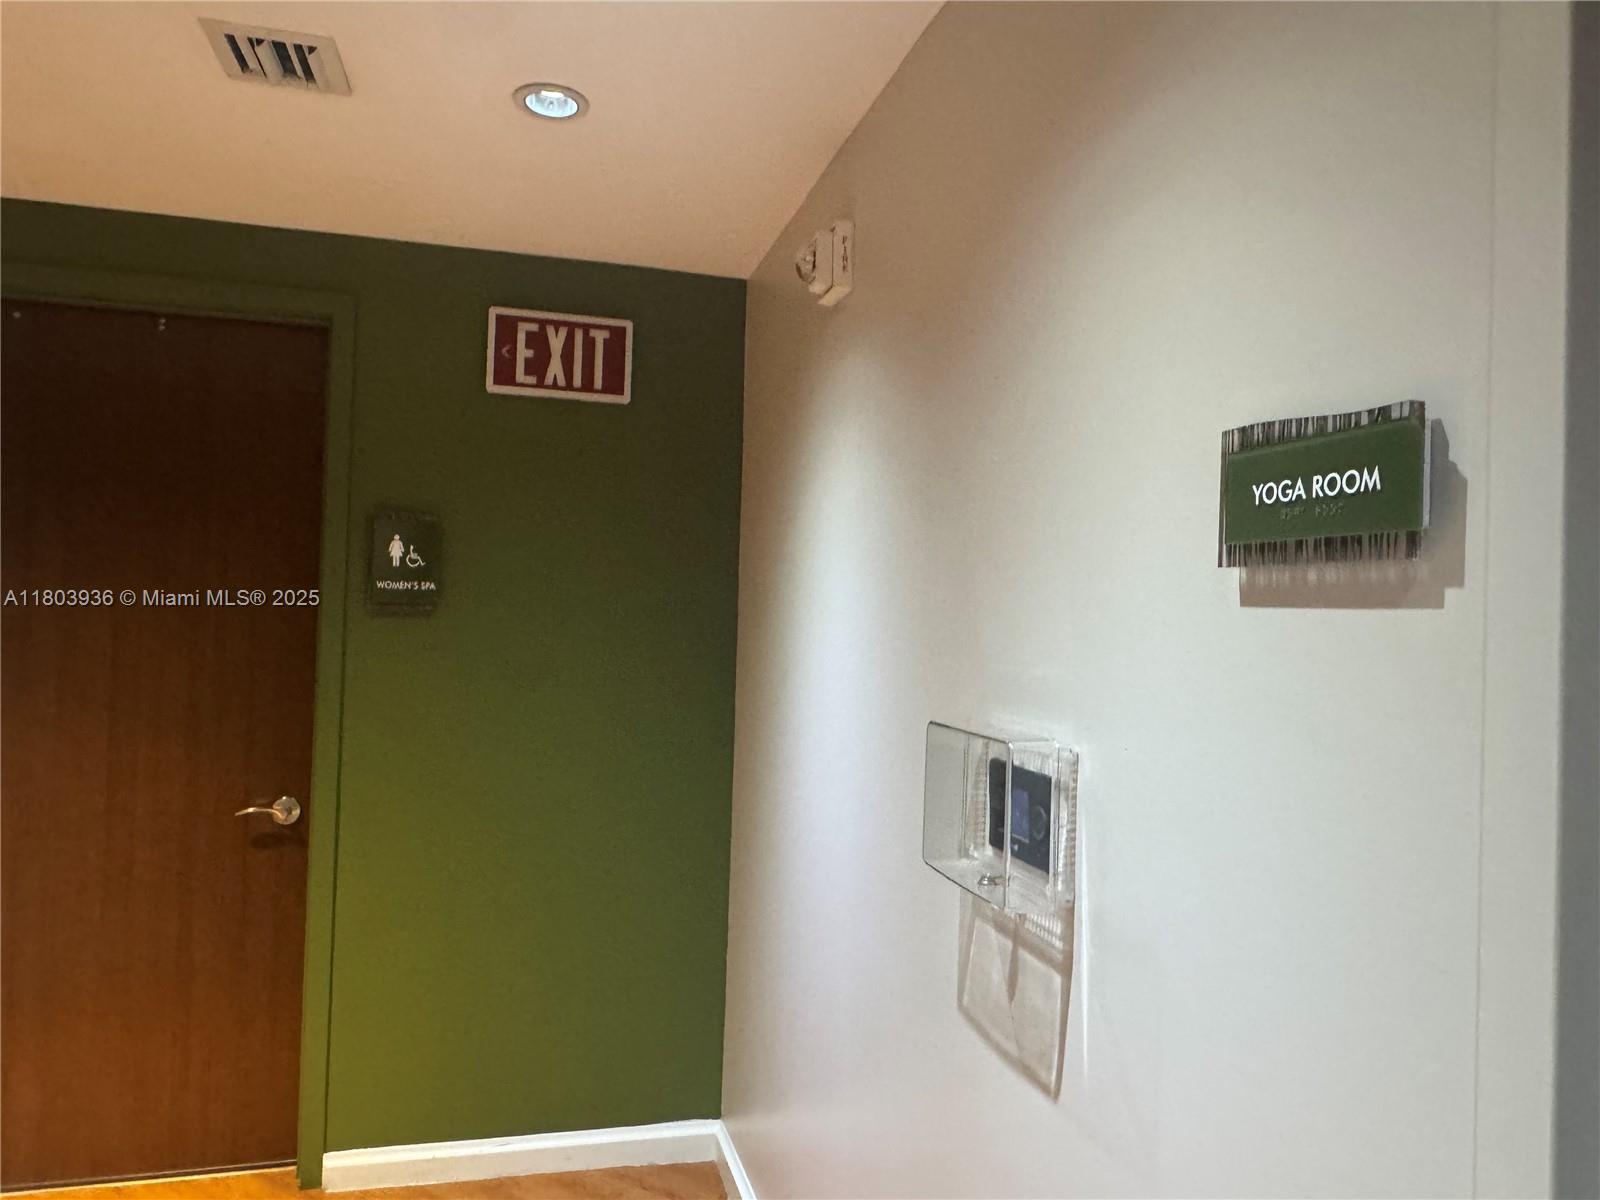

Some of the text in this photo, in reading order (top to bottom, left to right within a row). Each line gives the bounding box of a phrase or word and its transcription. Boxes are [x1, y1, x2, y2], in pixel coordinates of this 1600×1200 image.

[516, 322, 610, 390] EXIT
[1252, 465, 1381, 506] YOGA ROOM
[376, 580, 436, 590] WOMEN'S SPA
